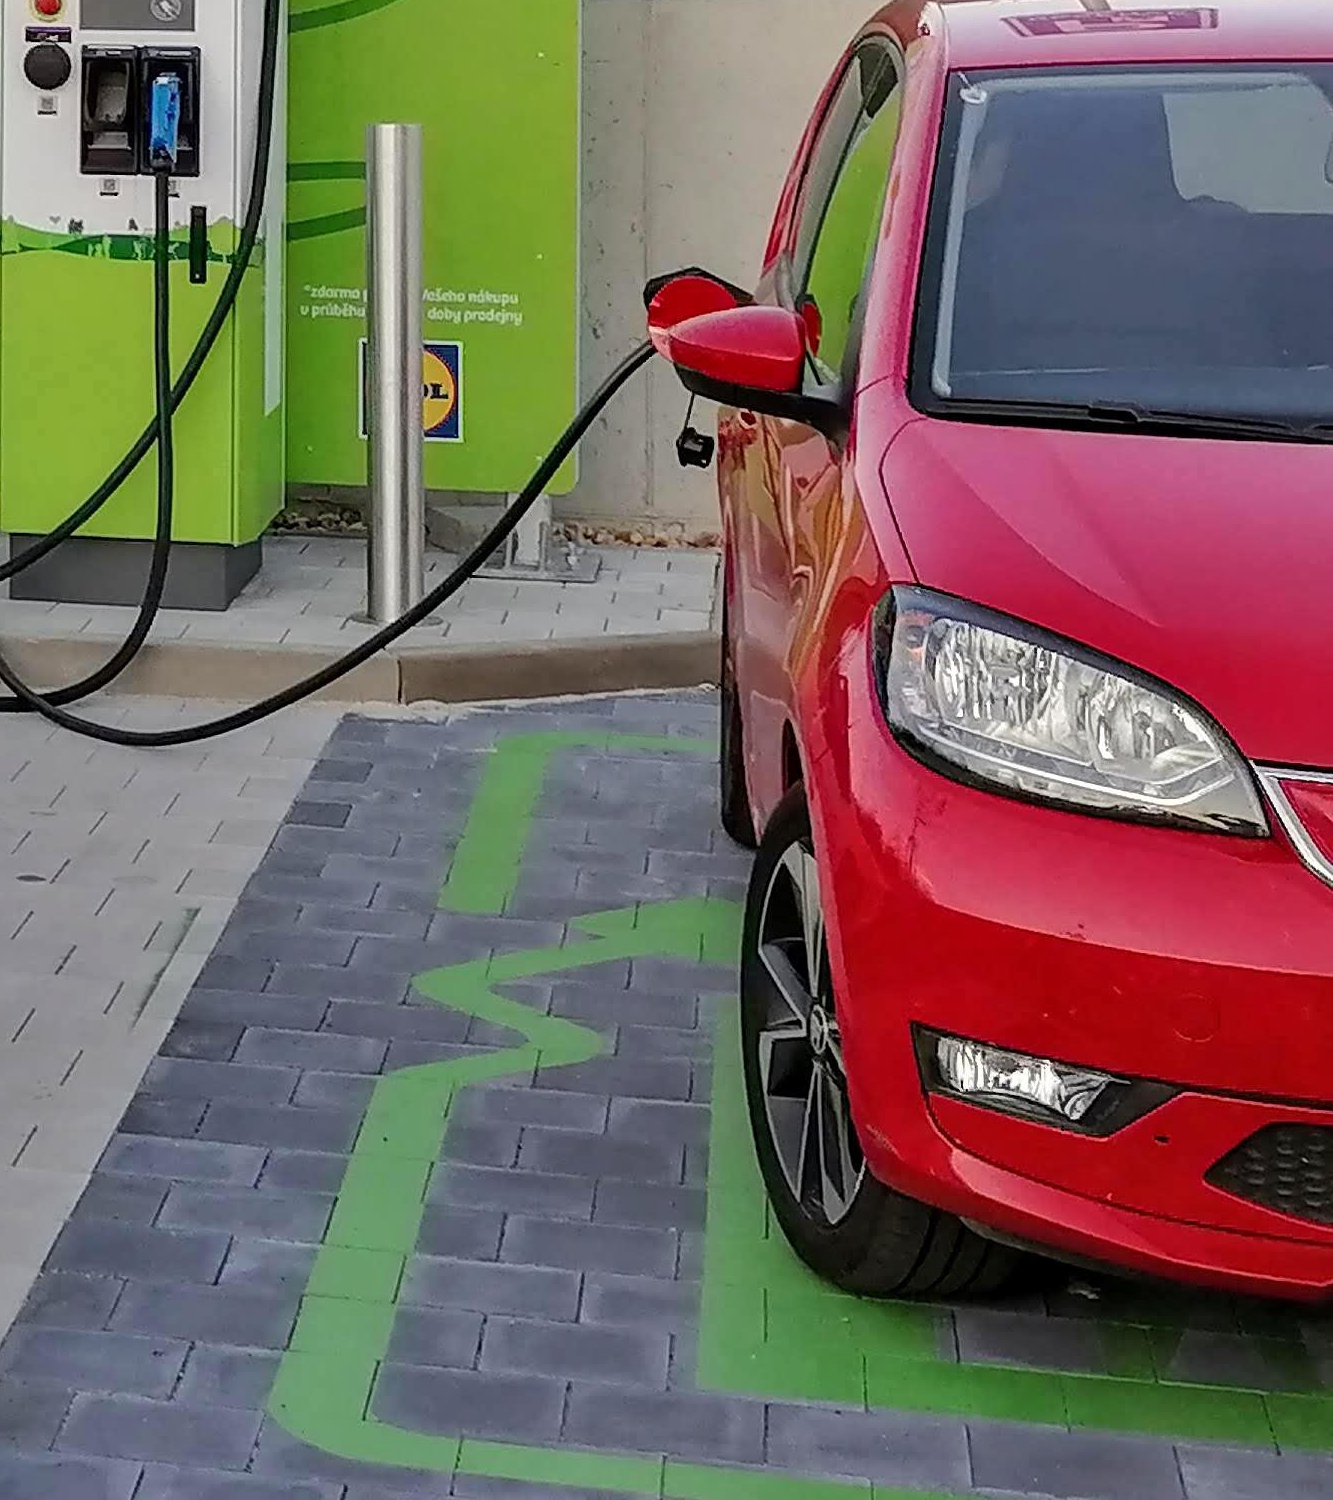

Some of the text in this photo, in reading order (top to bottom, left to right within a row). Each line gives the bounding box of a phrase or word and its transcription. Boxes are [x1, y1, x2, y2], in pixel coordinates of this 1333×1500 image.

[467, 289, 519, 306] nákupu
[427, 307, 462, 323] doby
[463, 308, 523, 326] prodejny
